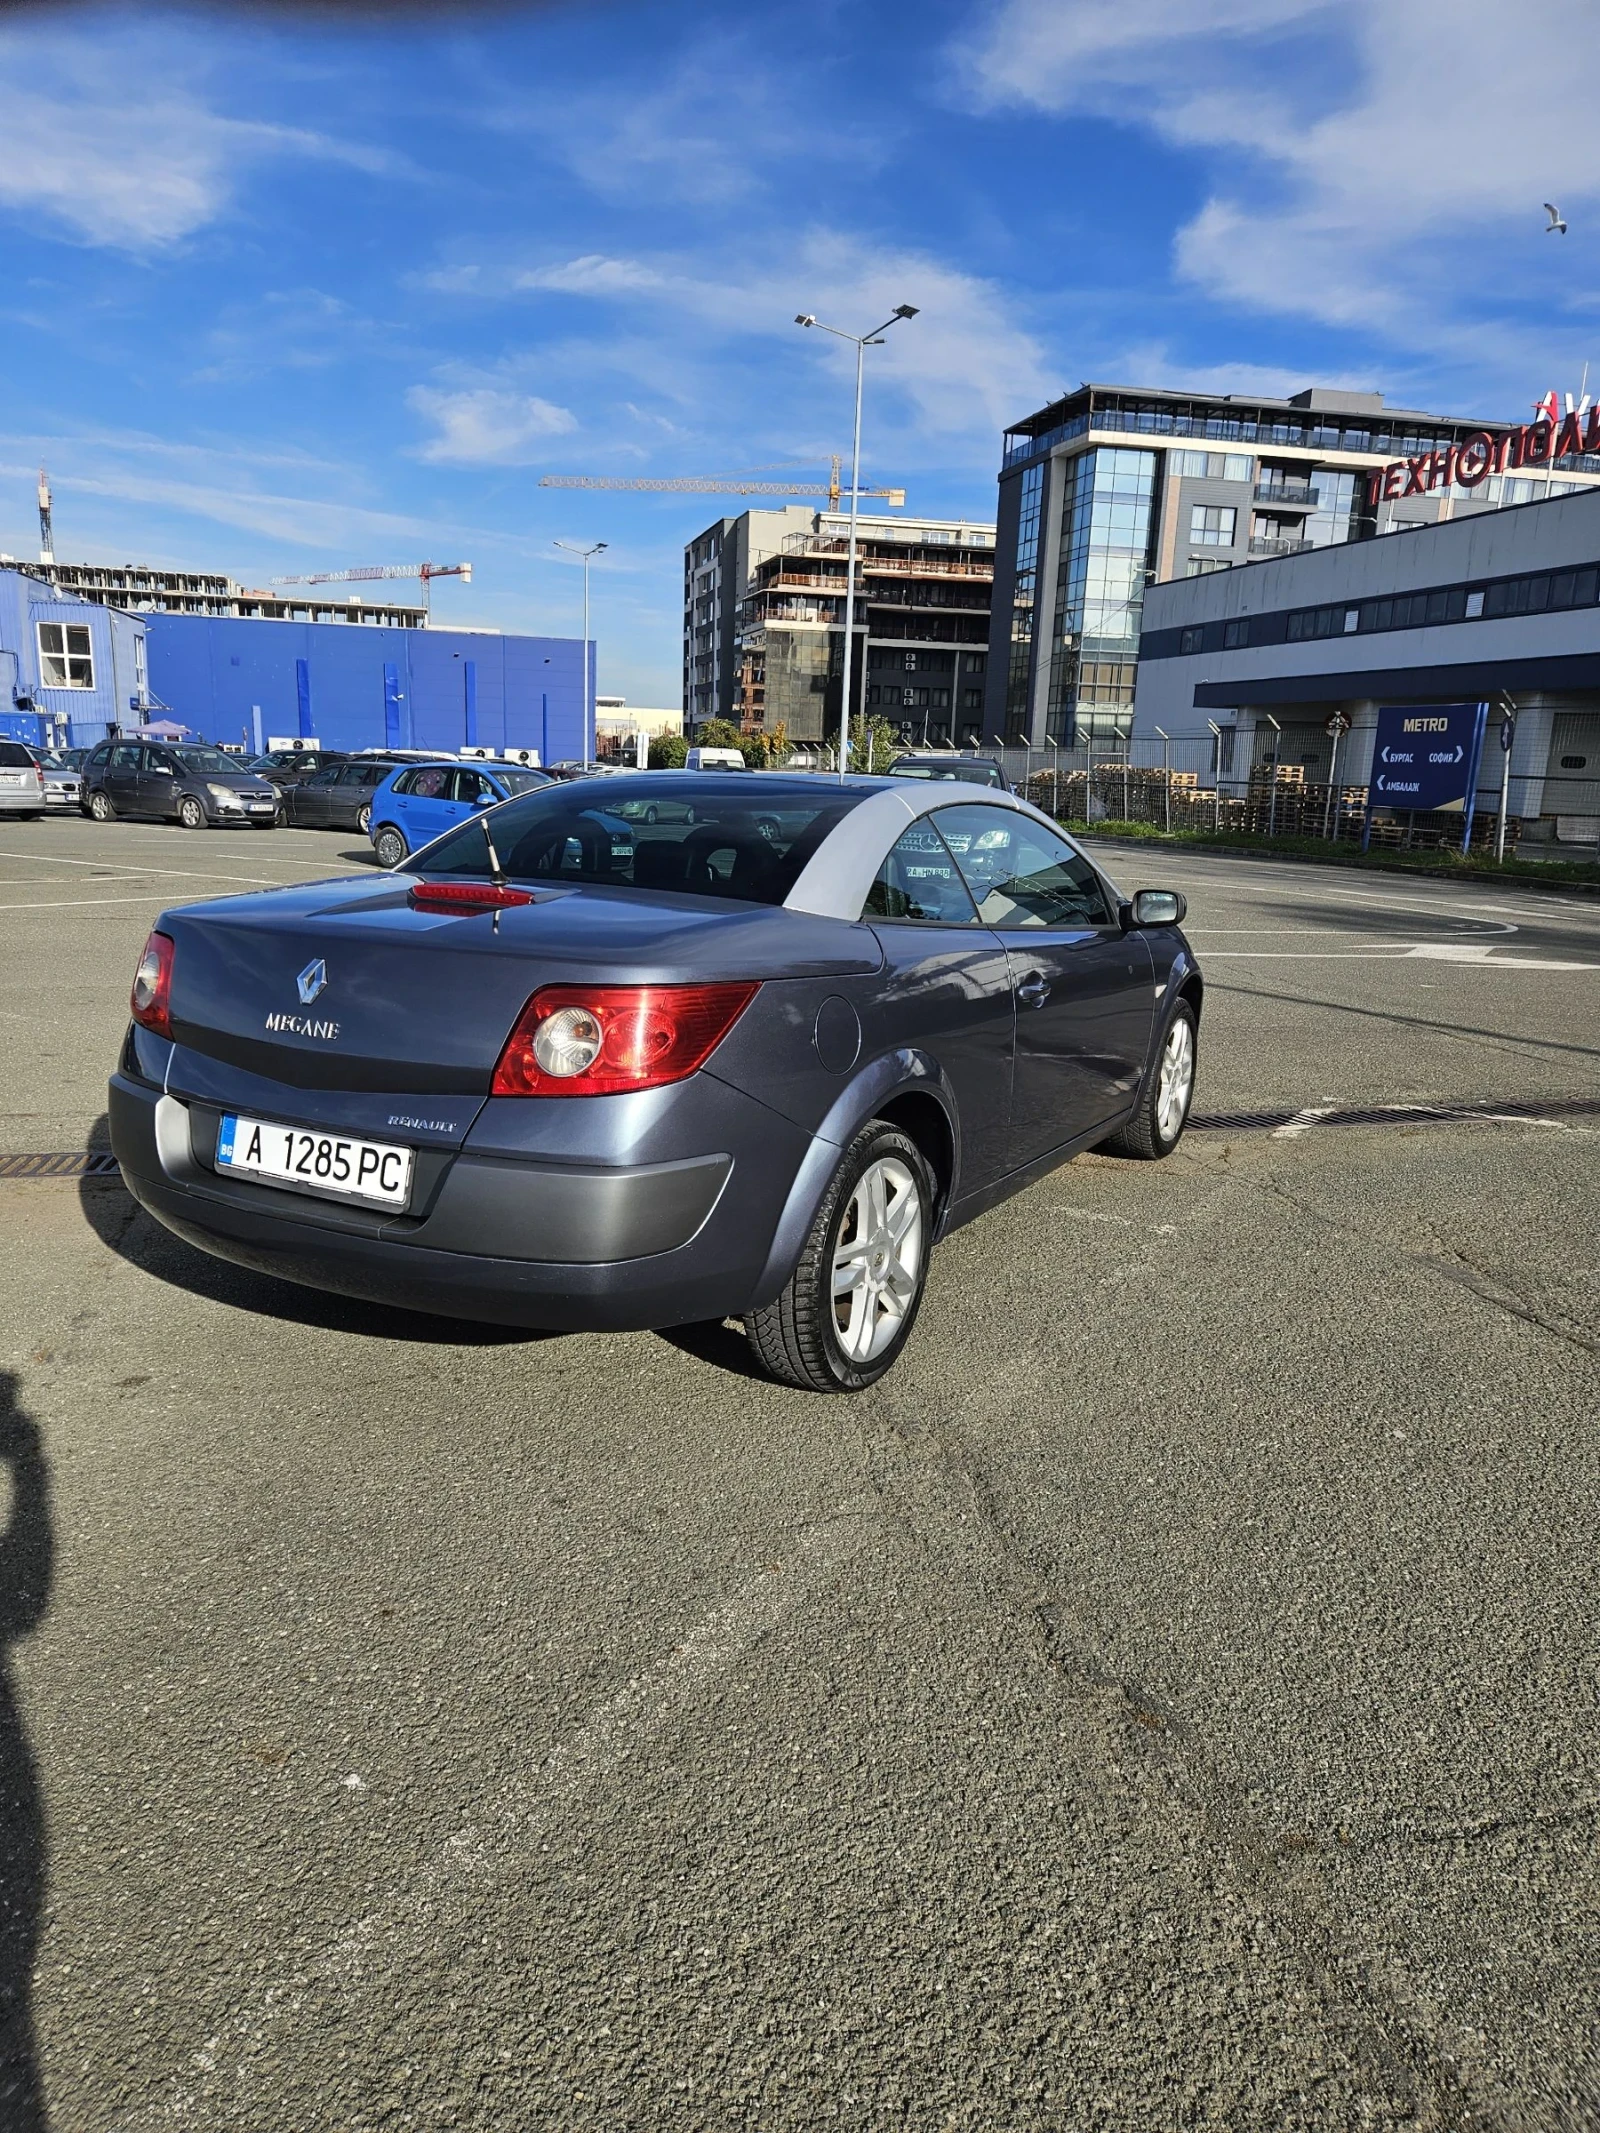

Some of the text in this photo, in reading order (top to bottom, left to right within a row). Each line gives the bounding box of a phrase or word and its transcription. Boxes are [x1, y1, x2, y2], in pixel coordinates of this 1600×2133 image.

[1403, 718, 1448, 732] METRO
[1390, 753, 1414, 763] БУРГАС
[1428, 752, 1453, 763] СОФИЯ
[1386, 782, 1420, 792] АМБАЛАЖ
[265, 1012, 340, 1040] MEGANE
[388, 1115, 457, 1132] RENAULT
[220, 1143, 233, 1157] BG
[246, 1125, 402, 1192] A 1285 PC
